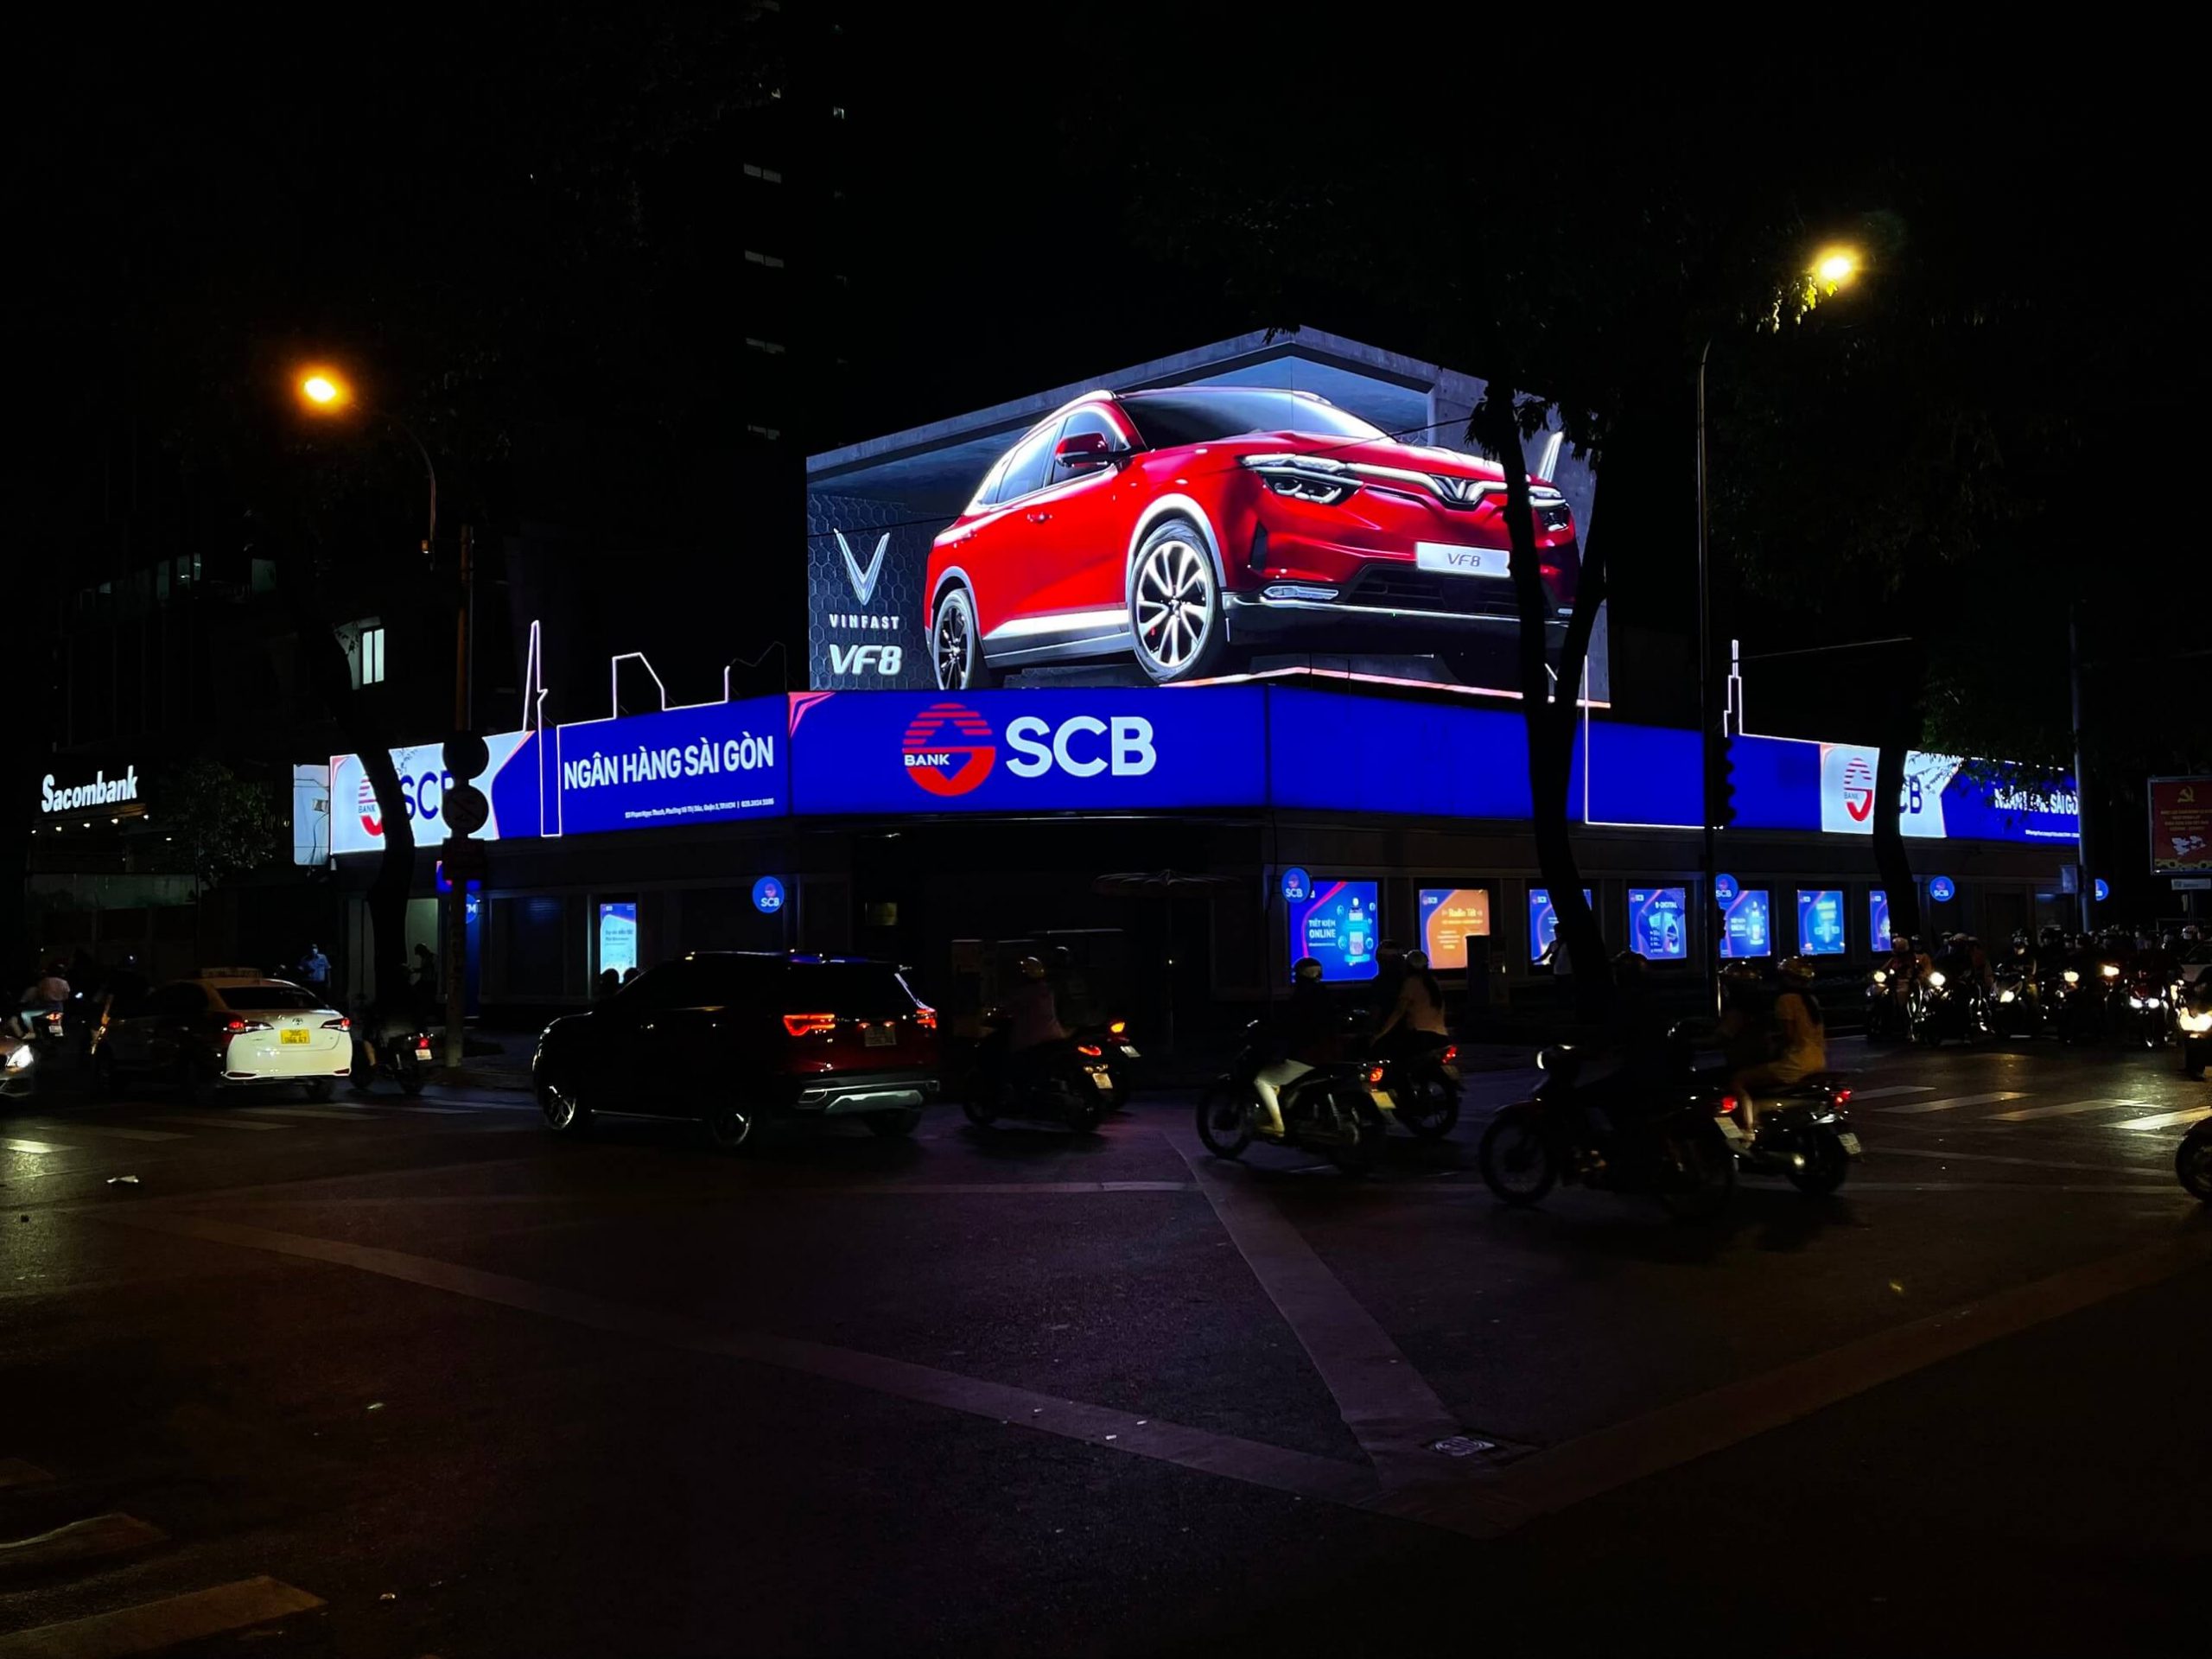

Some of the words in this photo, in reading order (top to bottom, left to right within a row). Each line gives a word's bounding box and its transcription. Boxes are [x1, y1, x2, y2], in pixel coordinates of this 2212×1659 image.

[1447, 553, 1481, 567] VF8
[829, 613, 899, 629] VINFAST
[829, 644, 902, 675] VF8
[1005, 715, 1157, 778] SCB
[563, 752, 619, 790] NGÂN
[622, 746, 681, 784] HÀNG
[684, 737, 720, 777] SÀI
[723, 731, 774, 772] GÒN
[904, 753, 950, 766] BANK
[41, 765, 138, 812] Sacombank
[358, 804, 376, 814] BANK
[2065, 791, 2078, 815] GÒ
[1285, 887, 1303, 898] SCB
[760, 897, 779, 907] SCB
[1309, 929, 1336, 938] ONLINE
